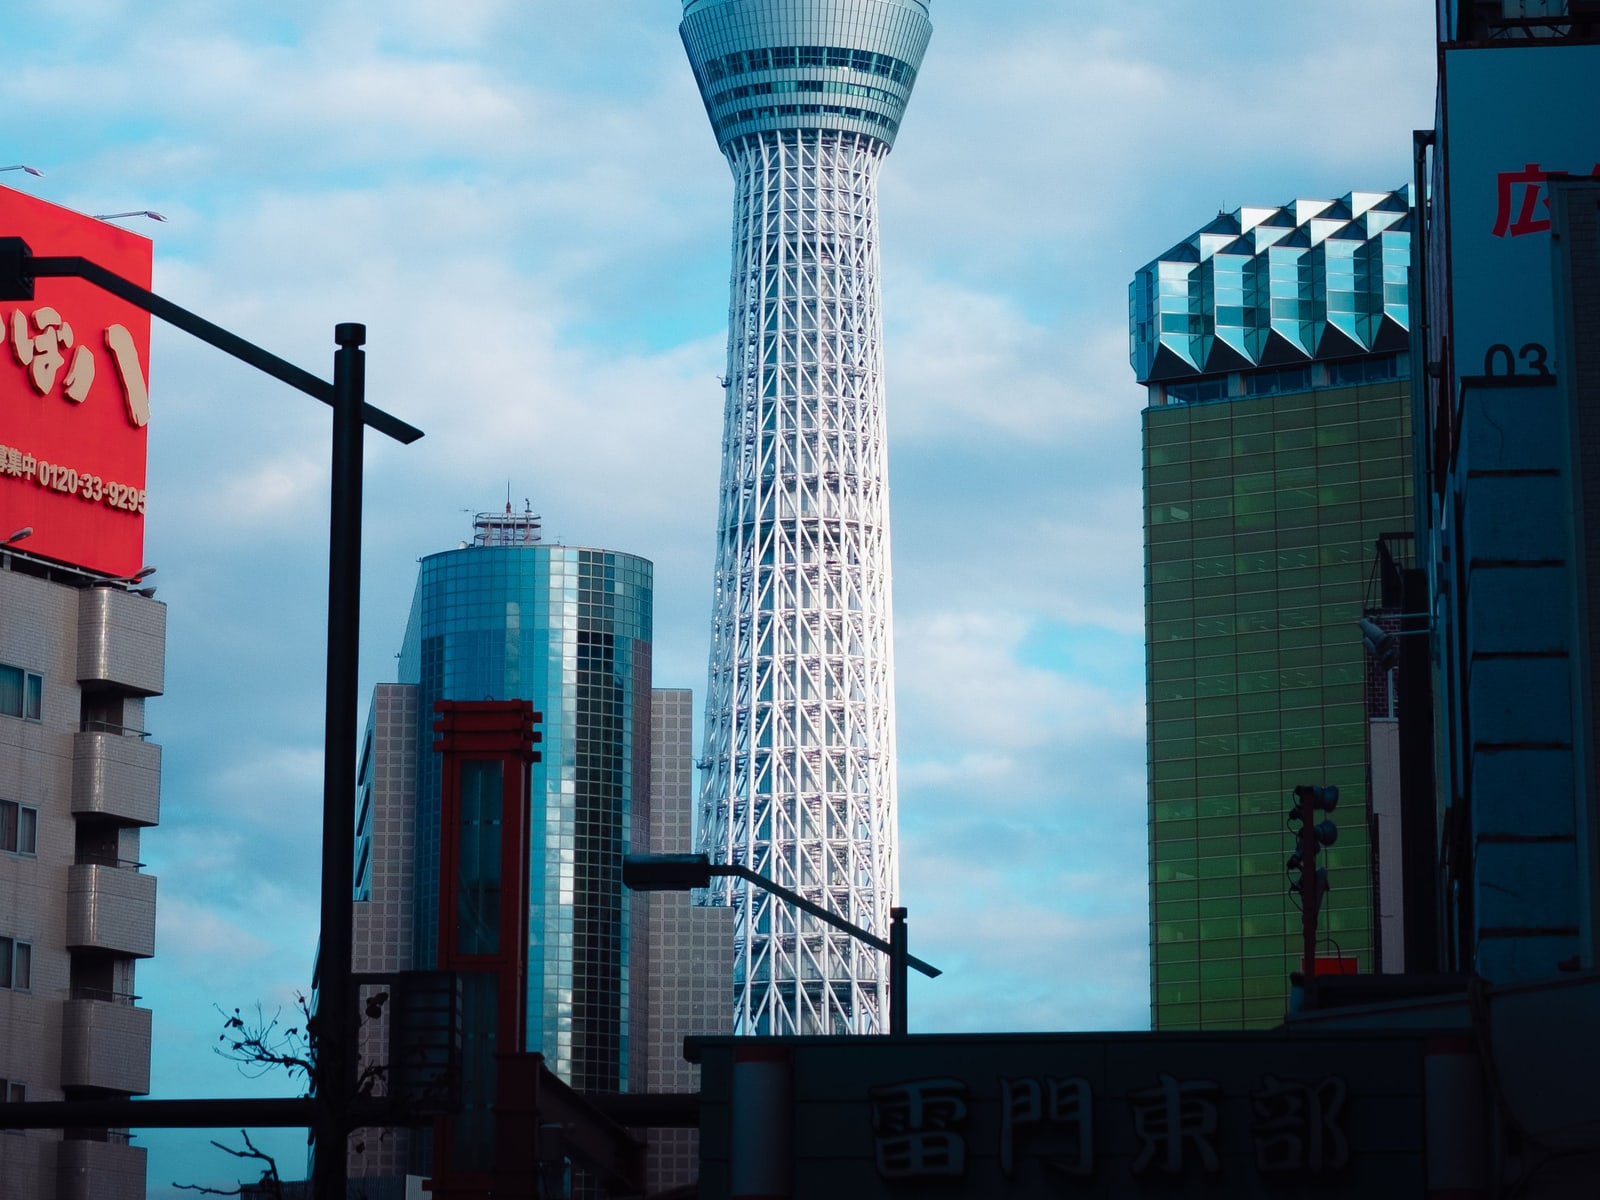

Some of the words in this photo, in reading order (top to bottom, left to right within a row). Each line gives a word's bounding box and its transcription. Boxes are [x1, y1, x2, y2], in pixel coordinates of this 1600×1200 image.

[1491, 164, 1600, 237] 広
[0, 307, 150, 427] ぼ八
[1485, 344, 1558, 379] 03
[38, 460, 147, 514] 0120-33-9295
[868, 1071, 1349, 1176] 雷門東部
